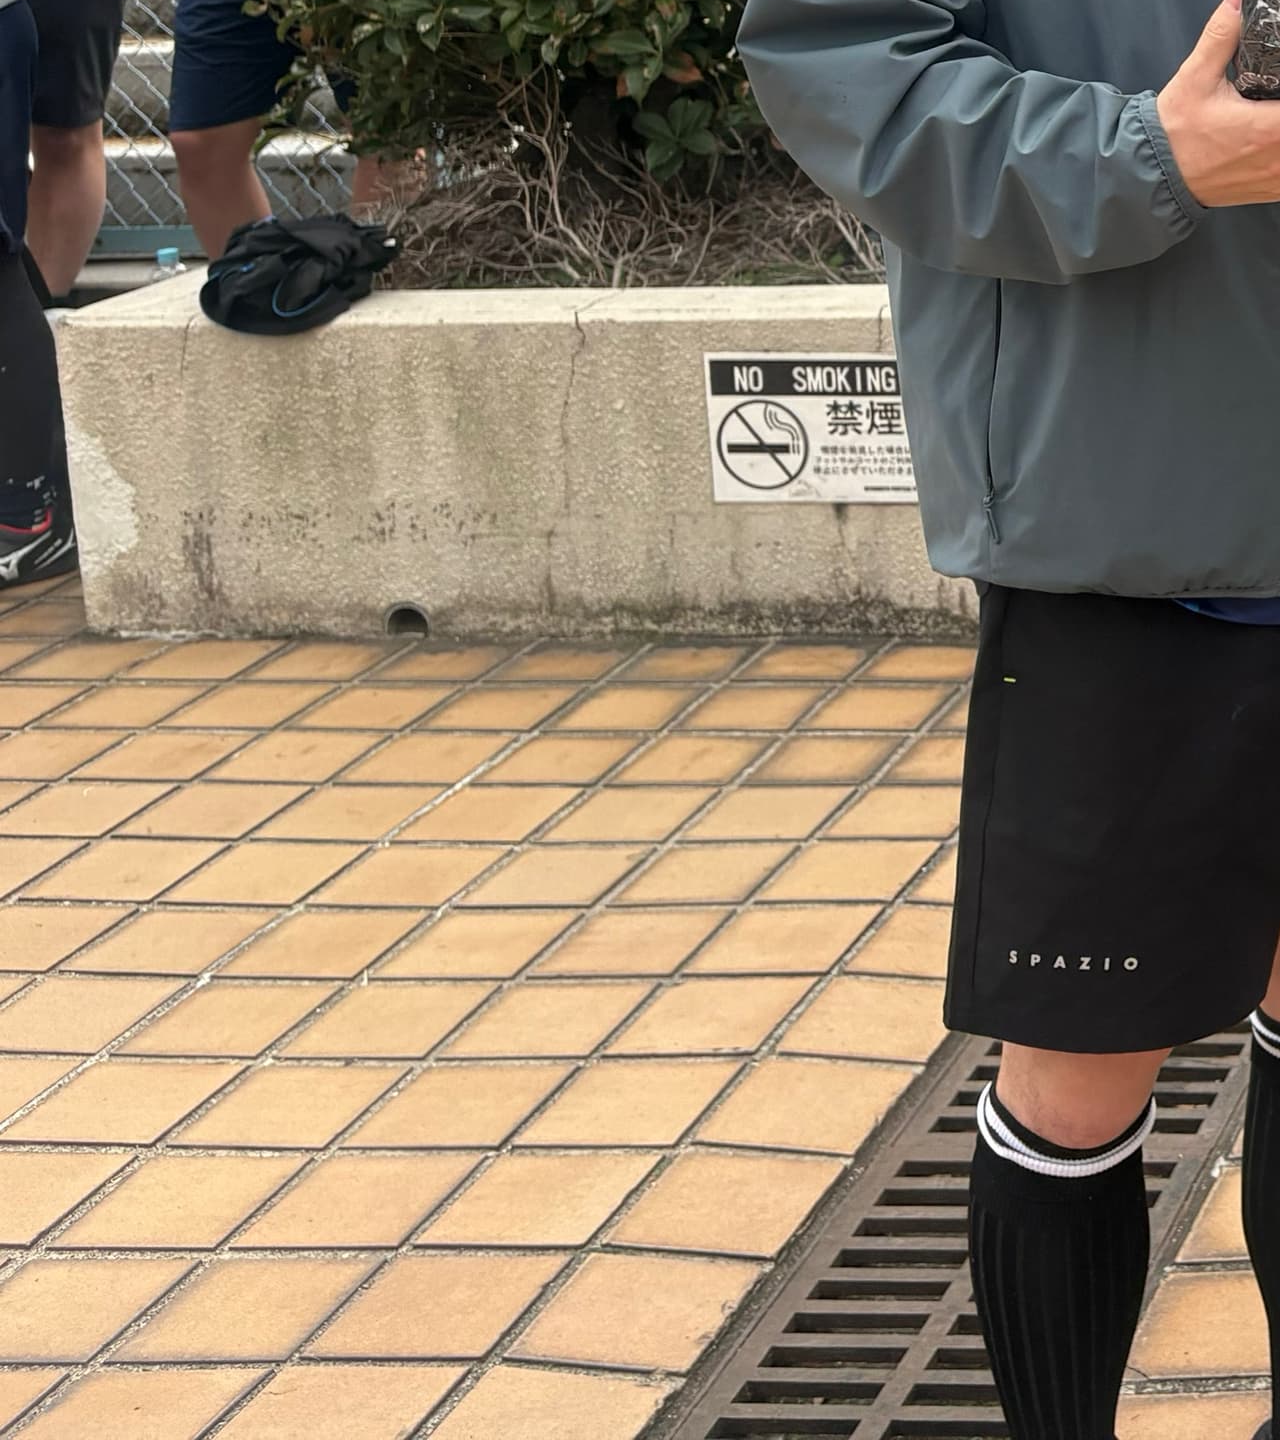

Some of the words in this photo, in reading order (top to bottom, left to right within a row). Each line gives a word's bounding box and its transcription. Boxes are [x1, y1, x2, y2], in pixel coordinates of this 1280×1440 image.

[733, 365, 764, 393] NO
[791, 365, 897, 393] SMOKING
[825, 400, 905, 436] 禁煙
[1009, 950, 1139, 971] SPAZIO
